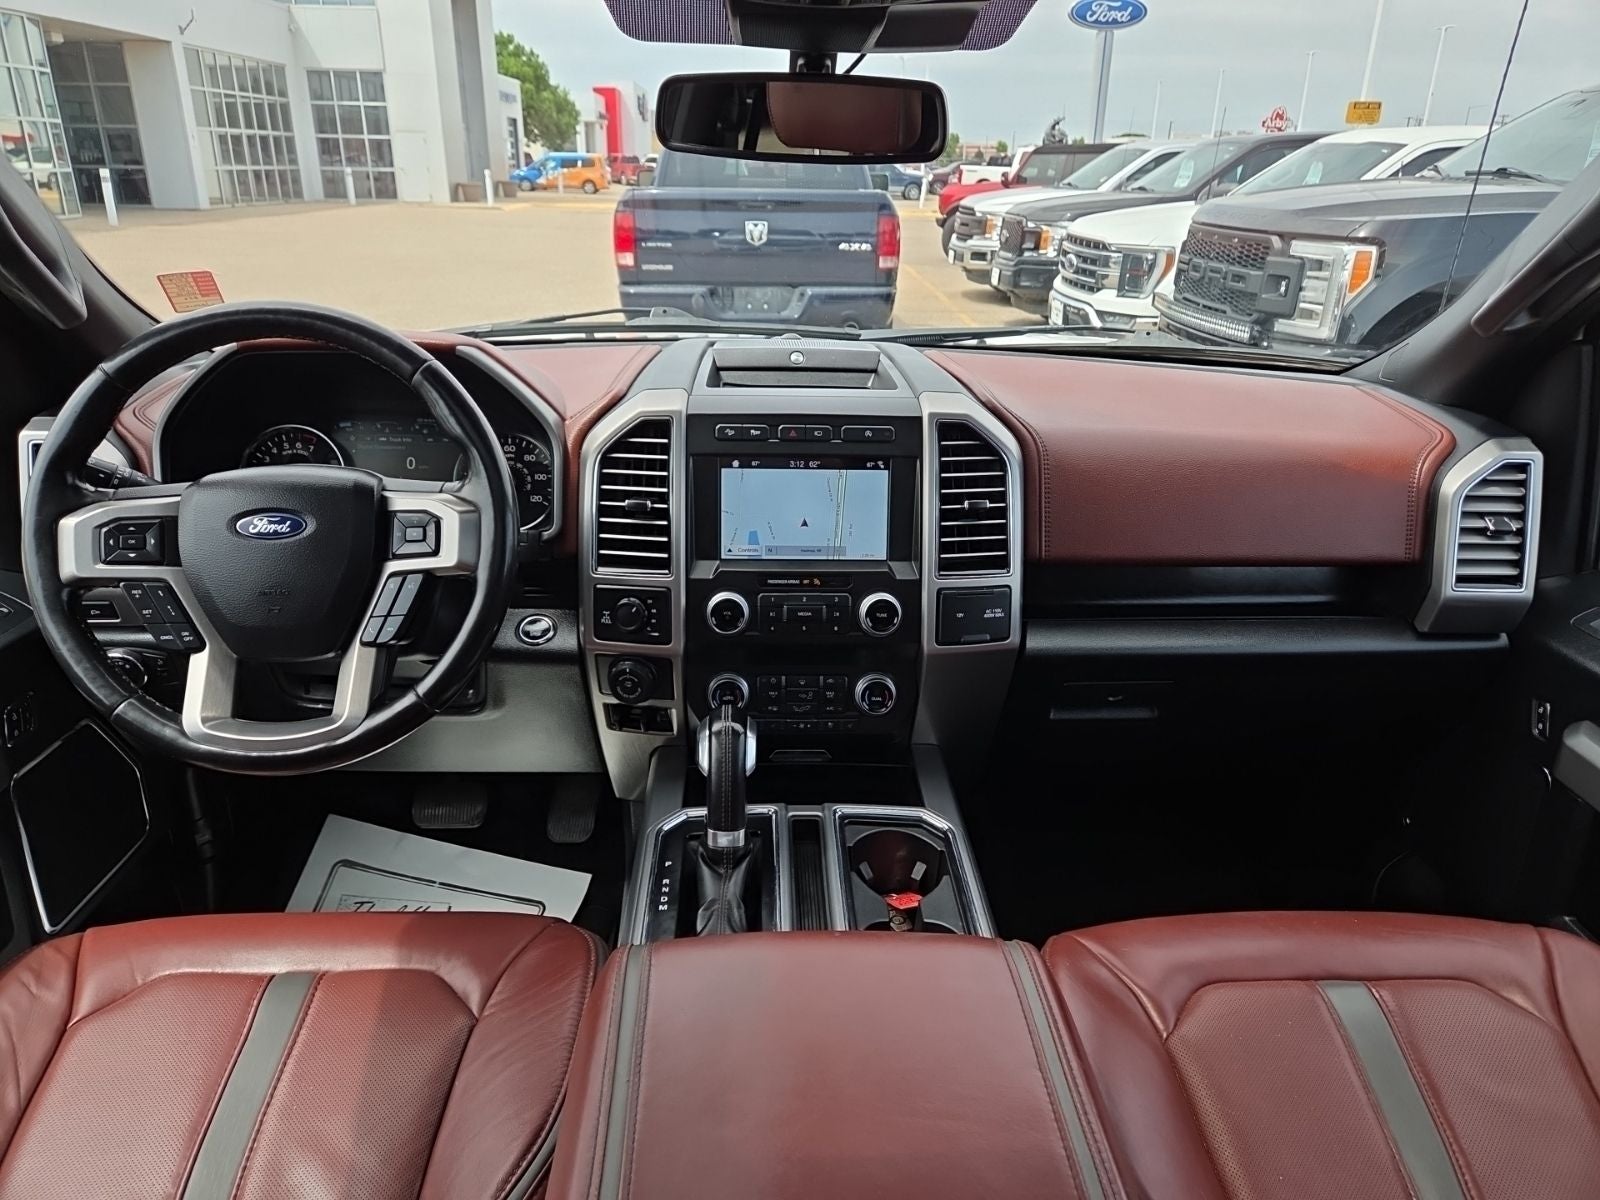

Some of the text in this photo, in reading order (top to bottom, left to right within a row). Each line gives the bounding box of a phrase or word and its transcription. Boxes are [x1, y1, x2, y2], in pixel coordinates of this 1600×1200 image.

[1086, 0, 1132, 22] Ford
[406, 456, 416, 470] 0
[248, 517, 292, 533] Ford
